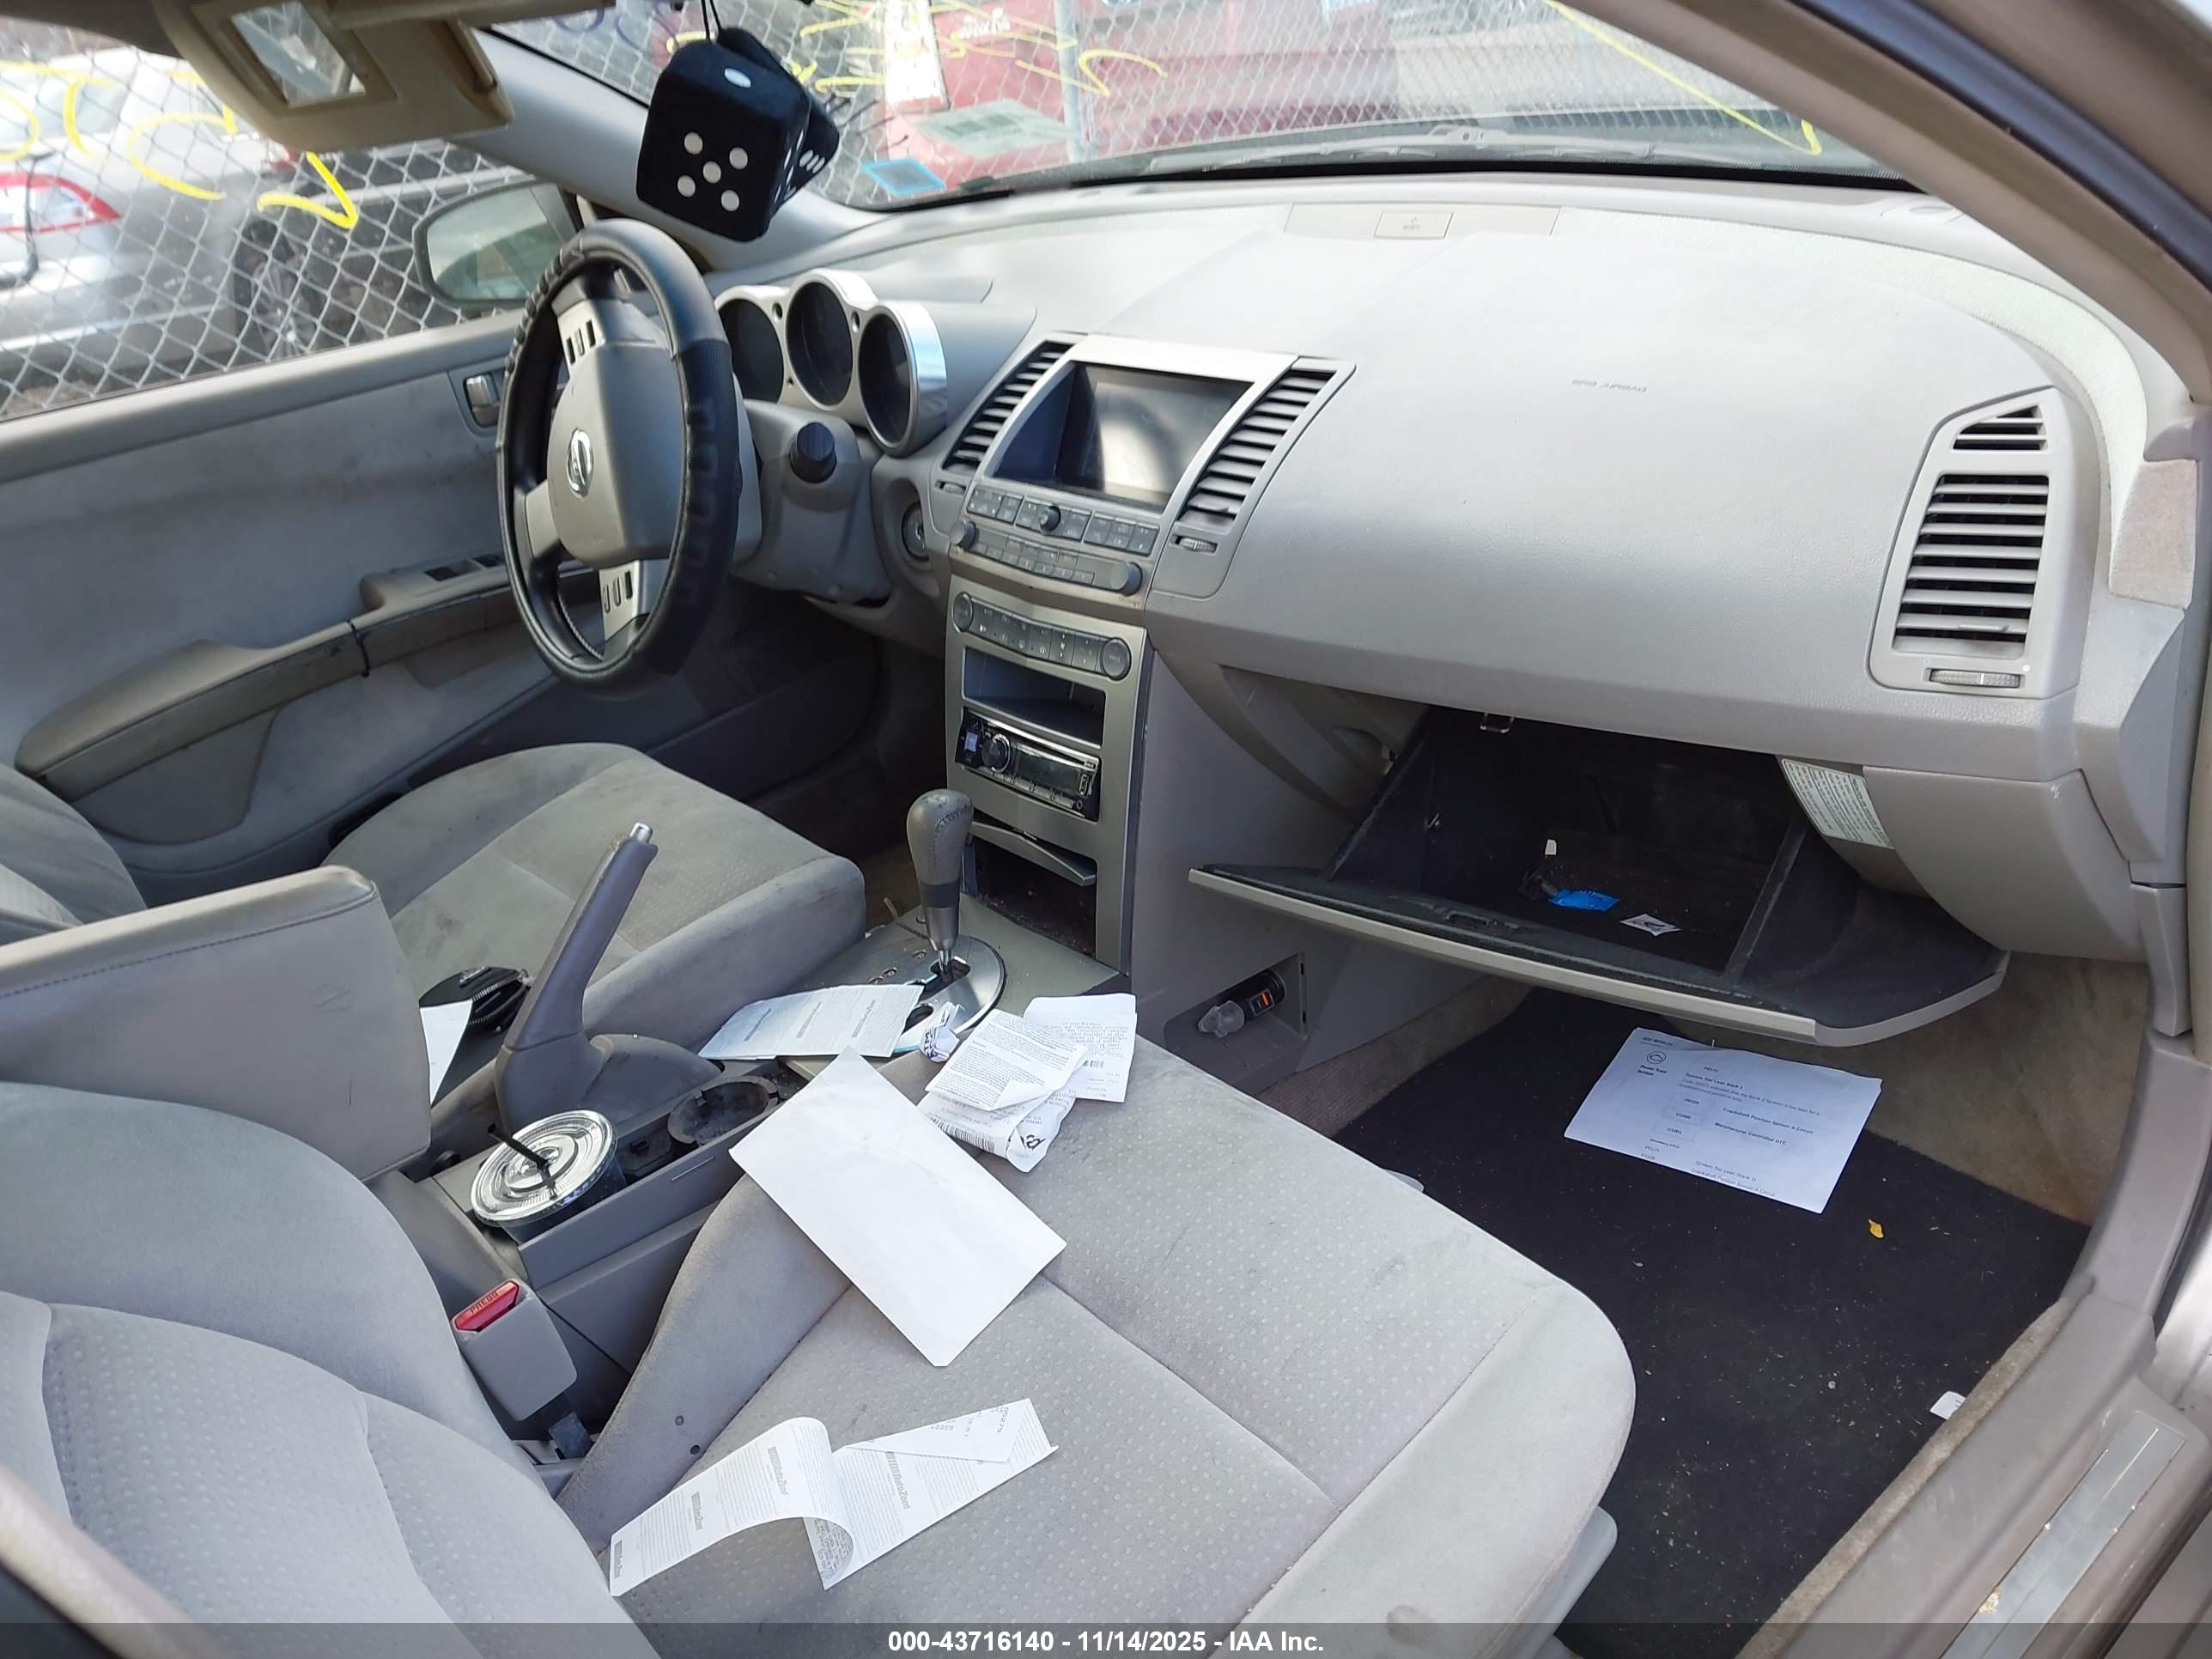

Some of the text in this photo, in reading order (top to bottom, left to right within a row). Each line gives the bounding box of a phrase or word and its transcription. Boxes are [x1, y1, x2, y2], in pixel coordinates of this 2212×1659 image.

[1601, 381, 1648, 392] AIRBAG
[1723, 1108, 1750, 1117] Crankshaft
[1751, 1115, 1771, 1123] Position
